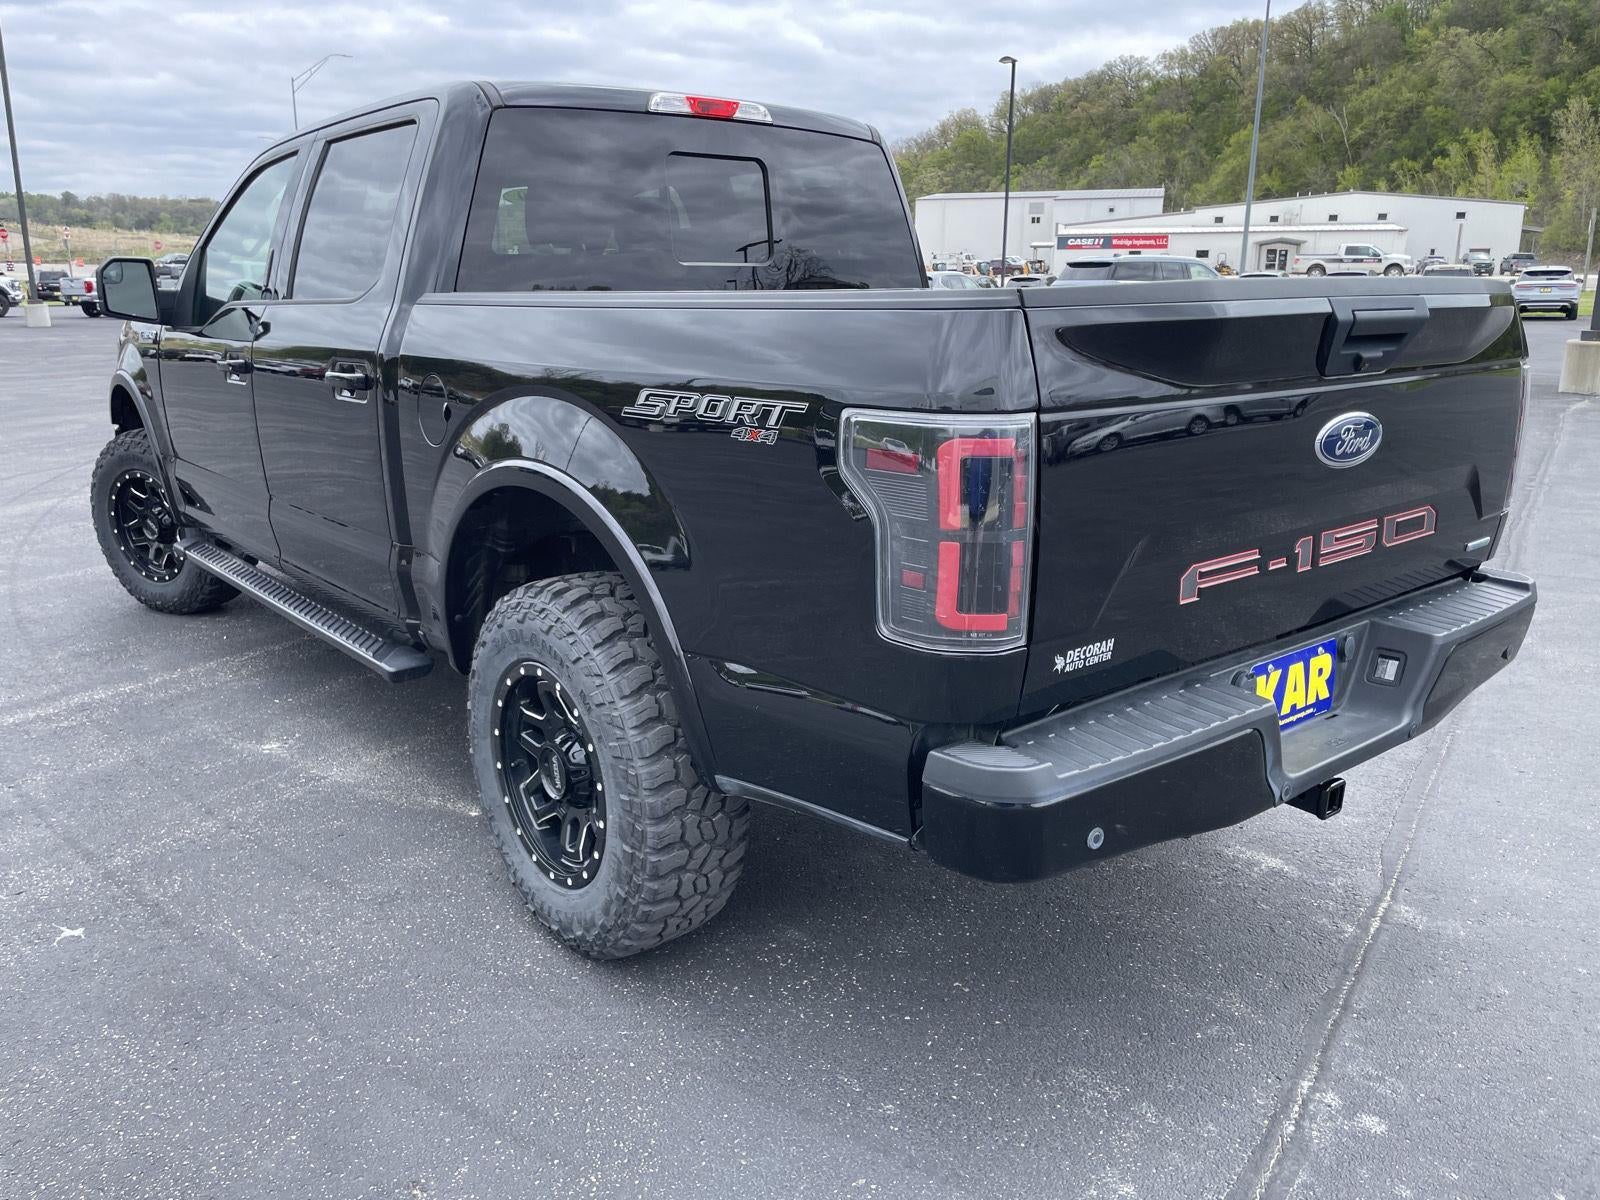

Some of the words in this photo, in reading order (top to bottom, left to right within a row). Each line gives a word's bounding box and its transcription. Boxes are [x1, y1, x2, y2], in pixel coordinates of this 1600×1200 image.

[621, 387, 809, 429] SPORT
[1335, 424, 1373, 456] Ford
[1179, 505, 1437, 605] F-150
[1064, 660, 1084, 673] AUTO
[1085, 651, 1112, 667] CENTER
[1065, 638, 1115, 664] DECORAH
